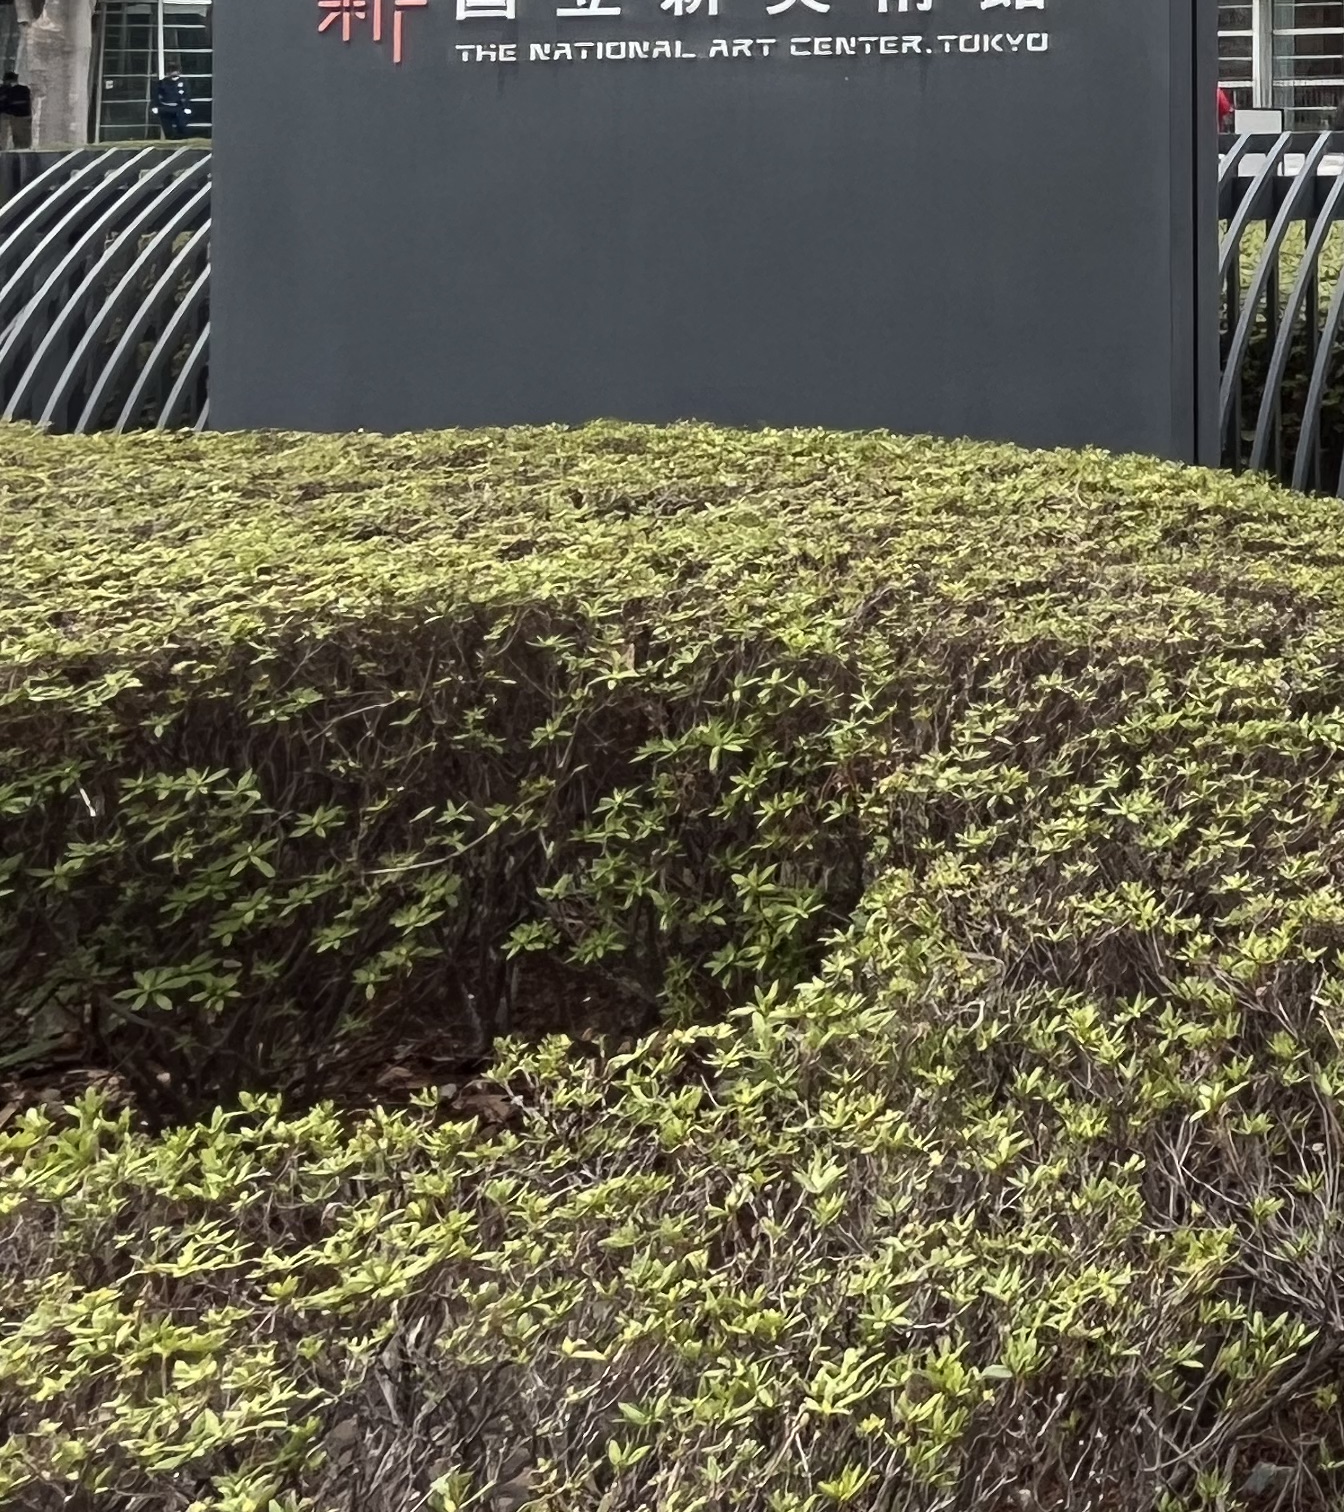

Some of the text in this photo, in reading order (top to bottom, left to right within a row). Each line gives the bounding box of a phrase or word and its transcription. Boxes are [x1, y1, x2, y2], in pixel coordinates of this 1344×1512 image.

[455, 44, 517, 62] THE
[529, 40, 697, 61] NATIONAL
[709, 39, 777, 57] ART
